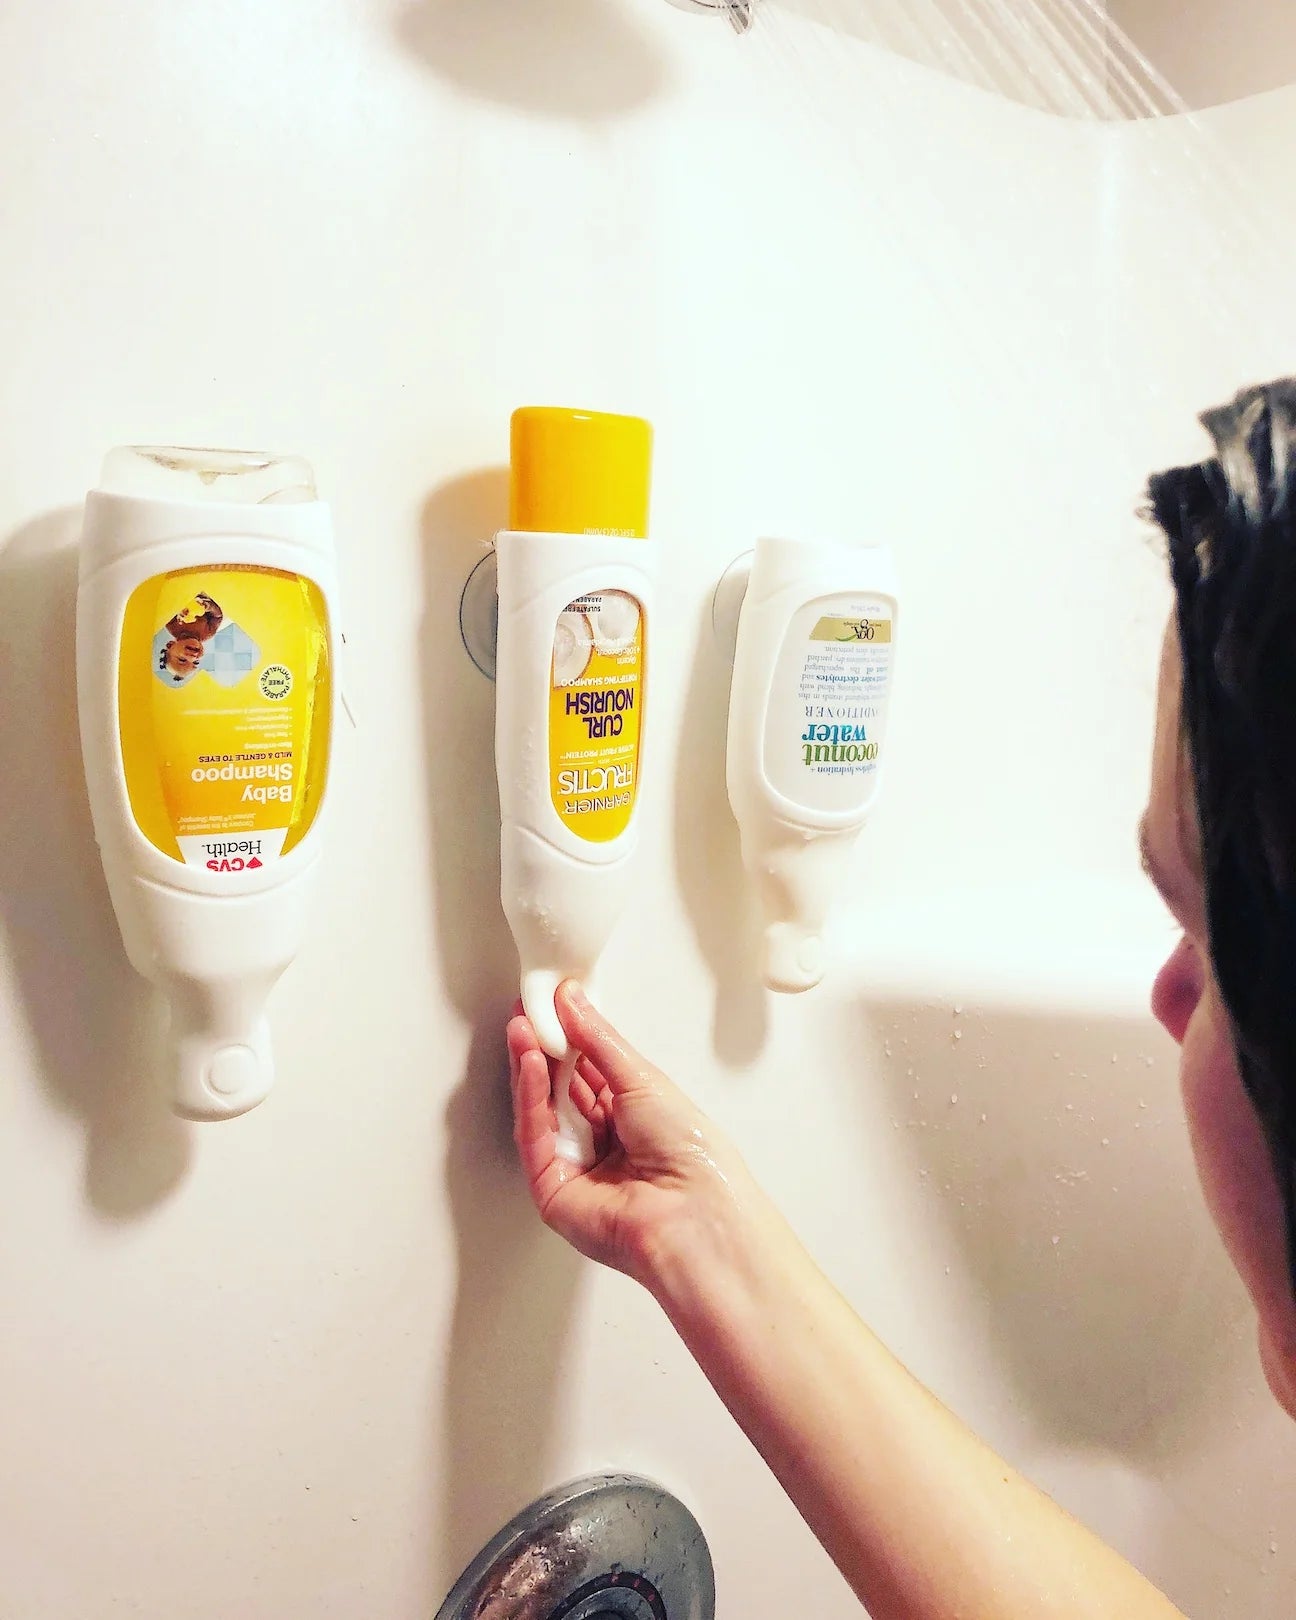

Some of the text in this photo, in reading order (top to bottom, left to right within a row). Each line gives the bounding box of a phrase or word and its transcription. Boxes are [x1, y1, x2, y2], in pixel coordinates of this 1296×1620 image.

[260, 666, 291, 682] PHTHALATE
[560, 676, 603, 686] SHAMPOO
[816, 674, 859, 684] electrolytes
[263, 684, 290, 700] PARABEN
[566, 688, 634, 714] NOURISH
[582, 714, 622, 738] CURL
[802, 724, 866, 745] water
[222, 754, 233, 762] TO
[236, 753, 266, 761] GENTLE
[191, 762, 293, 782] Shampoo
[558, 762, 633, 794] FRUCTIS
[818, 765, 854, 776] hydration
[240, 784, 292, 804] Baby
[564, 791, 630, 814] GARNIER
[206, 840, 262, 858] Health
[206, 858, 244, 872] CVS
